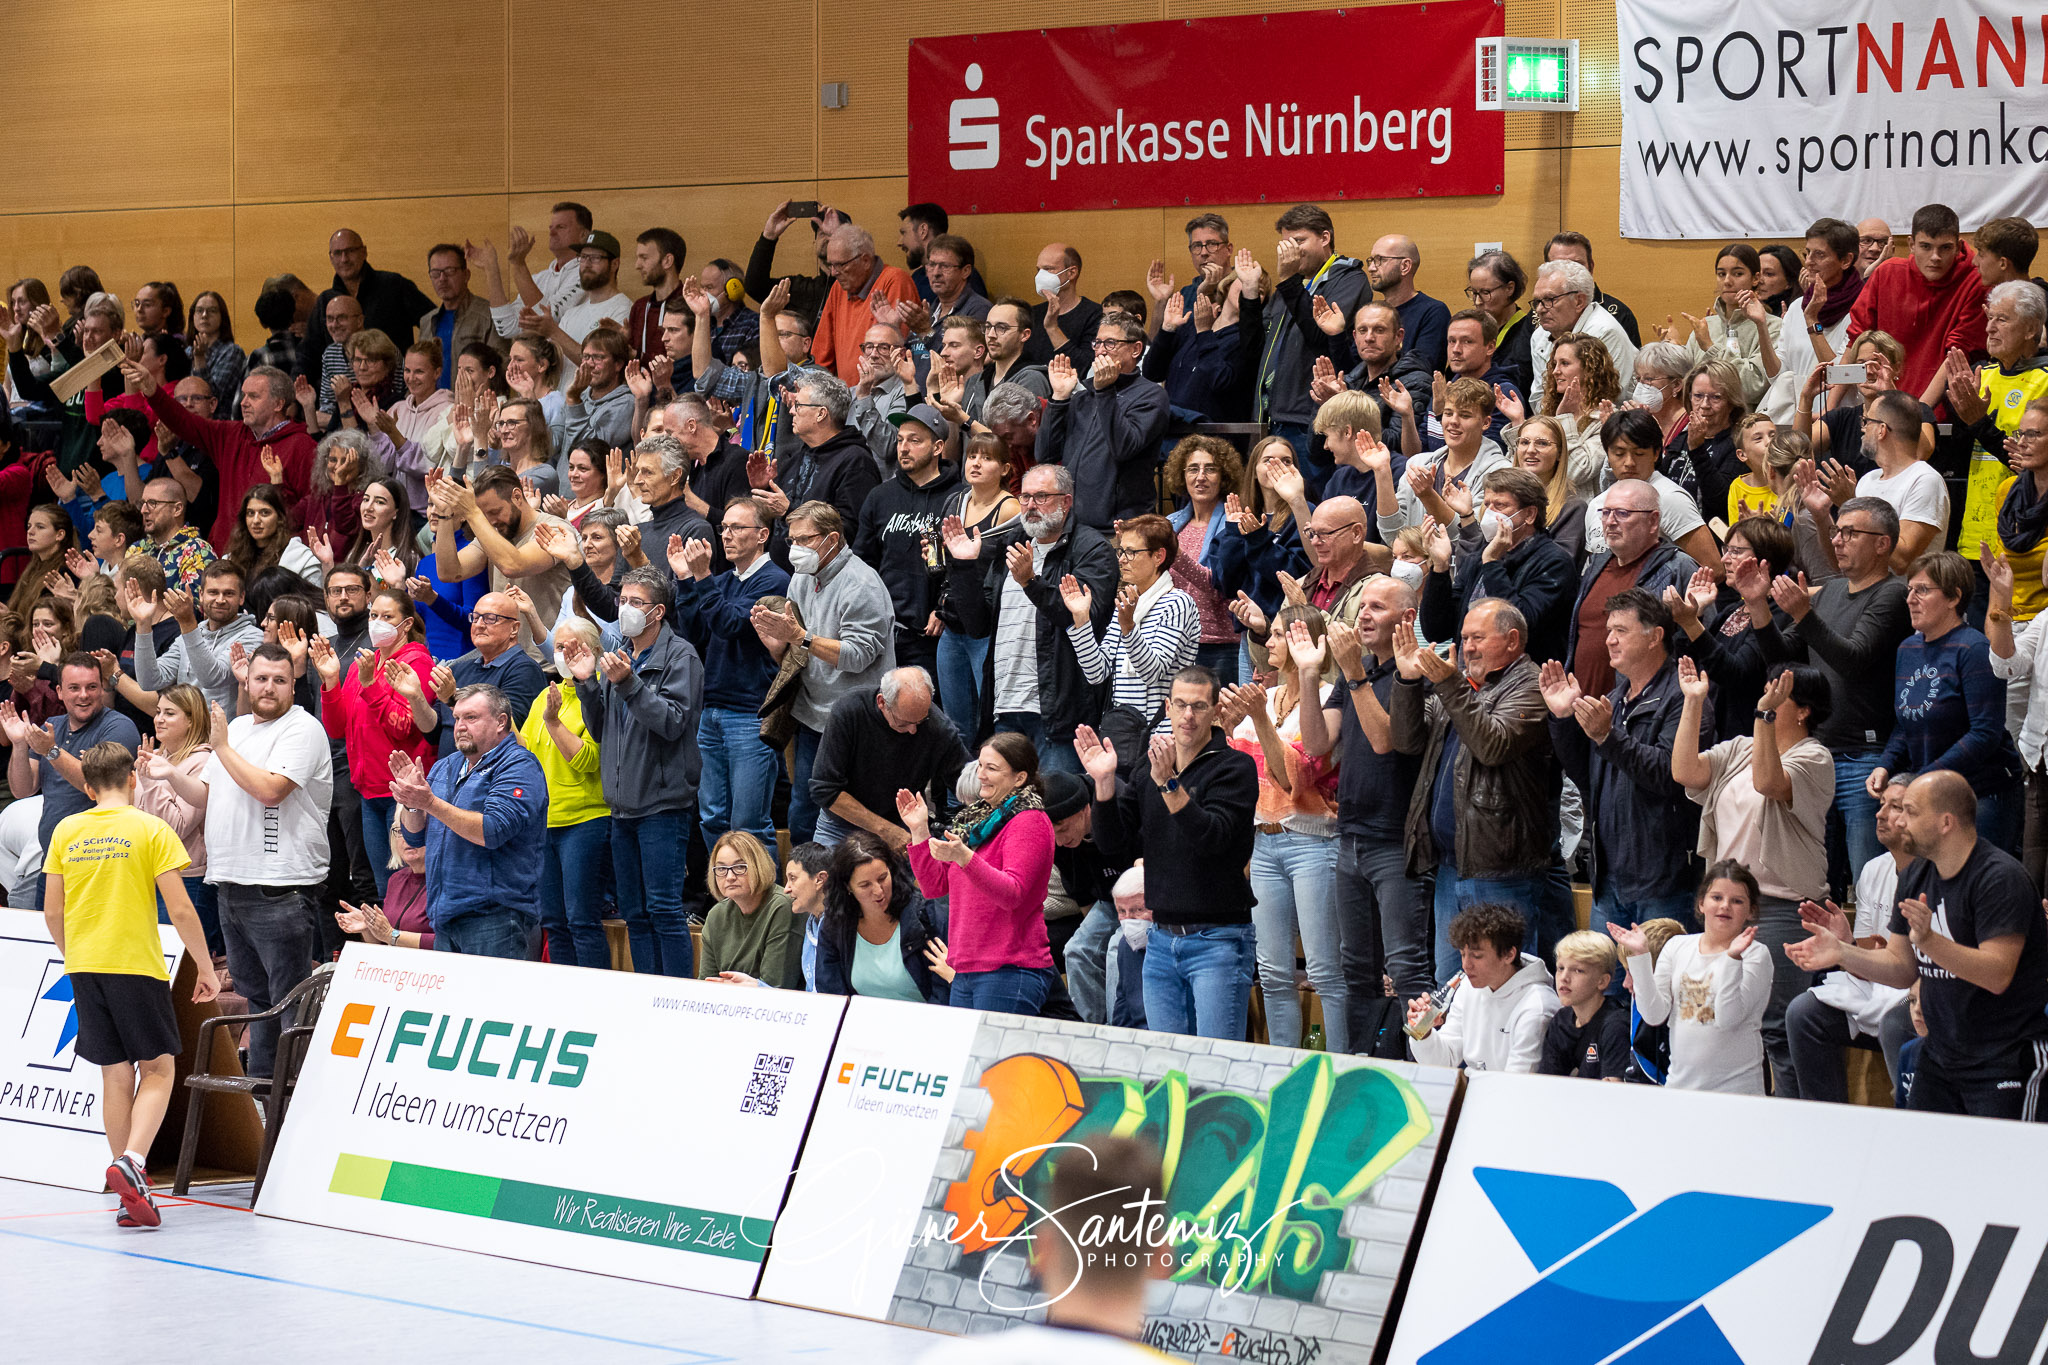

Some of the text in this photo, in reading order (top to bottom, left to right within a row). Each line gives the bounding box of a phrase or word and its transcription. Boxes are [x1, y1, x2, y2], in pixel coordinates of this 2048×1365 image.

[1633, 16, 2048, 104] SPORTNAN
[1025, 109, 1230, 180] Sparkasse
[1244, 95, 1453, 165] Nürnberg
[68, 836, 132, 852] SV SCHWAIG
[353, 961, 445, 992] Firmengruppe
[652, 996, 809, 1026] WWW.FIRMENGRUPPE-CFUCHS.DE
[386, 1009, 598, 1089] FUCHS
[0, 1081, 96, 1117] PARTNER
[861, 1065, 948, 1098] FUCHS
[368, 1082, 569, 1146] Ideen umsetzen
[854, 1094, 939, 1120] Ideen umsetzen
[553, 1195, 737, 1251] Wir Realisieren Ihre Ziele.
